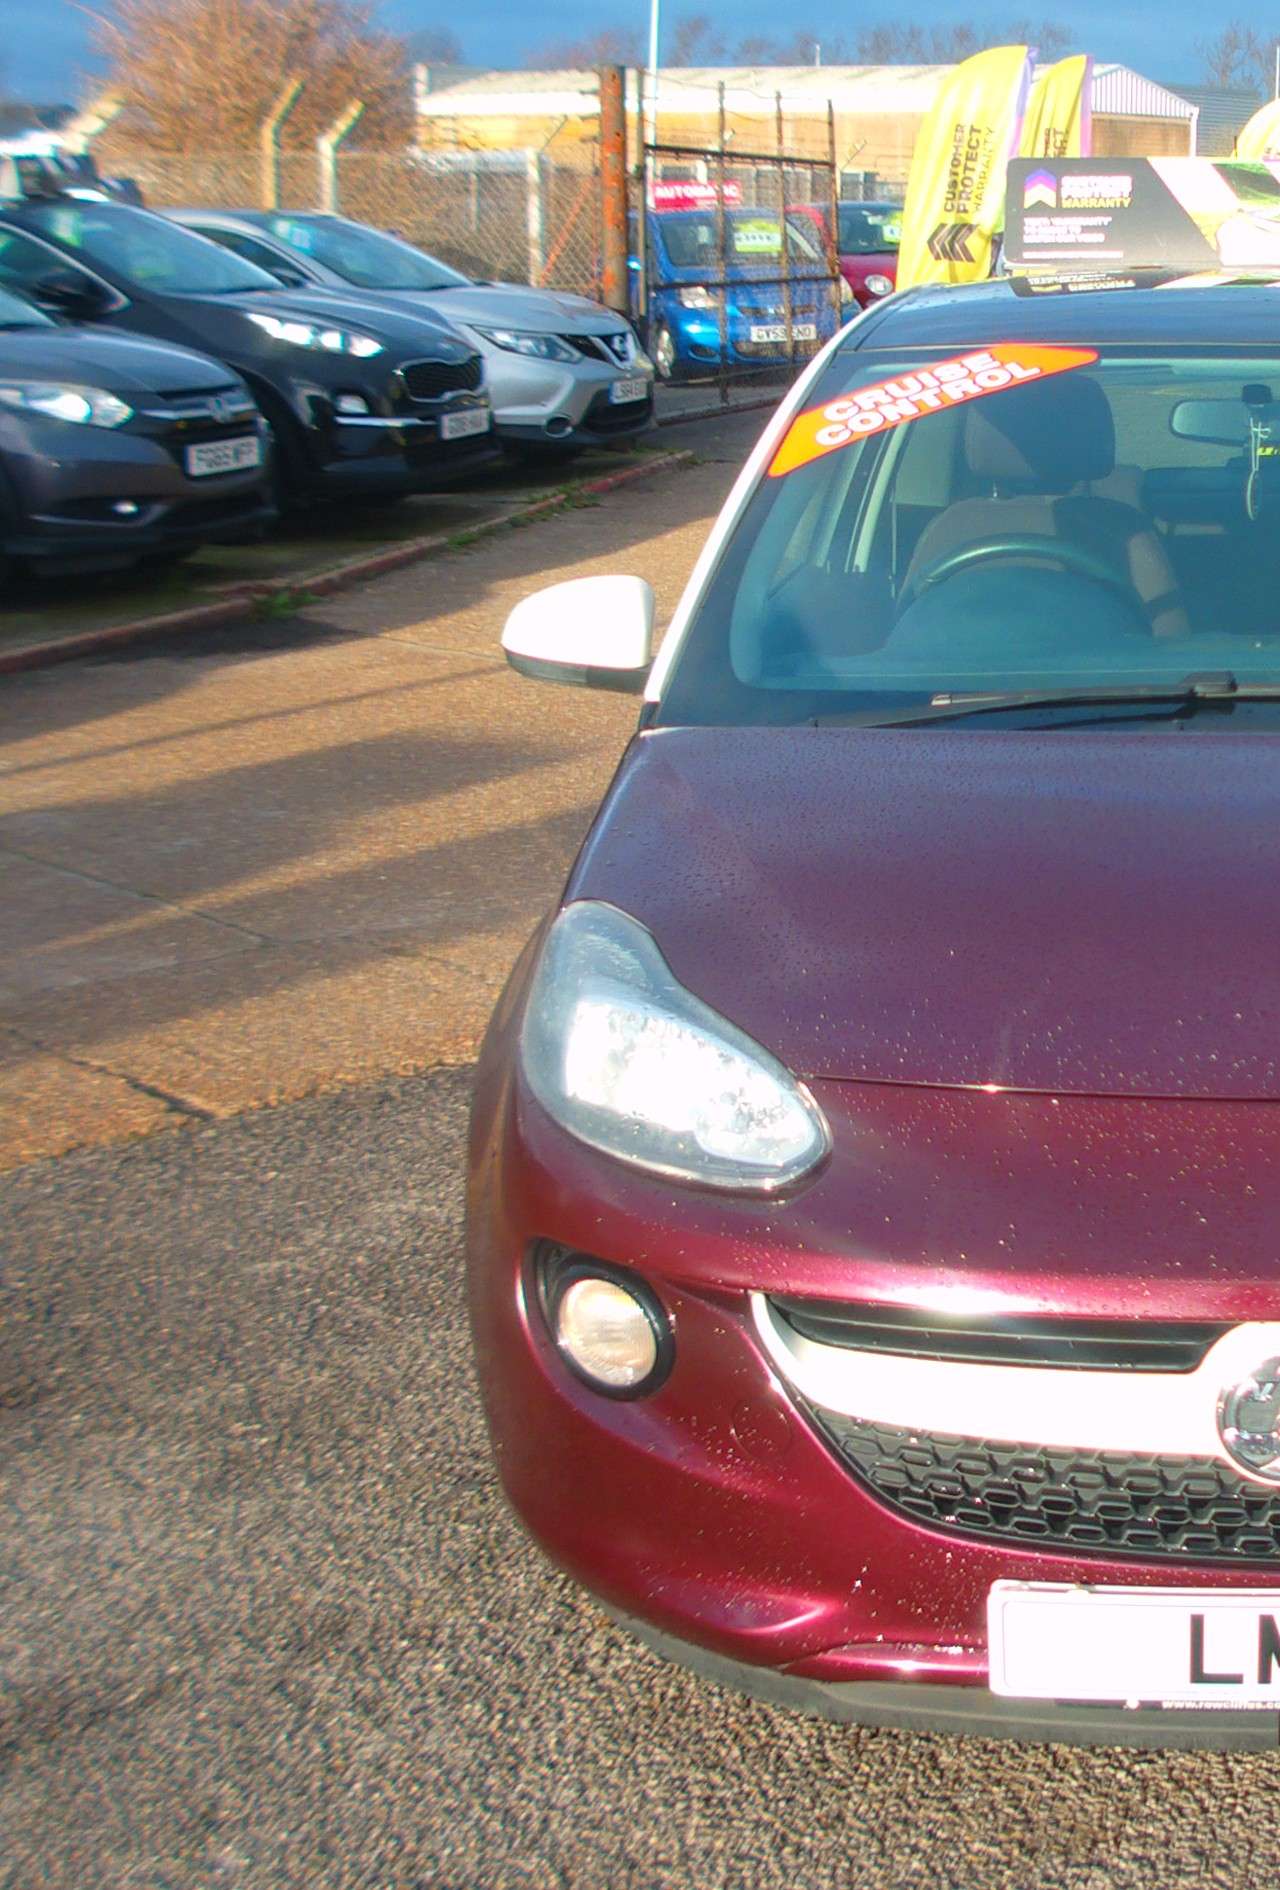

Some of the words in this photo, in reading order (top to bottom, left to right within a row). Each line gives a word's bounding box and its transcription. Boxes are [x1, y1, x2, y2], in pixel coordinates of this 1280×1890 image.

[656, 183, 738, 198] AUTOMAIC
[943, 123, 965, 213] CUSTOMER
[956, 124, 982, 214] PROTECT
[1061, 197, 1132, 209] WARRANTY
[815, 361, 1041, 446] CONTROL
[823, 352, 1001, 422] CRUISE
